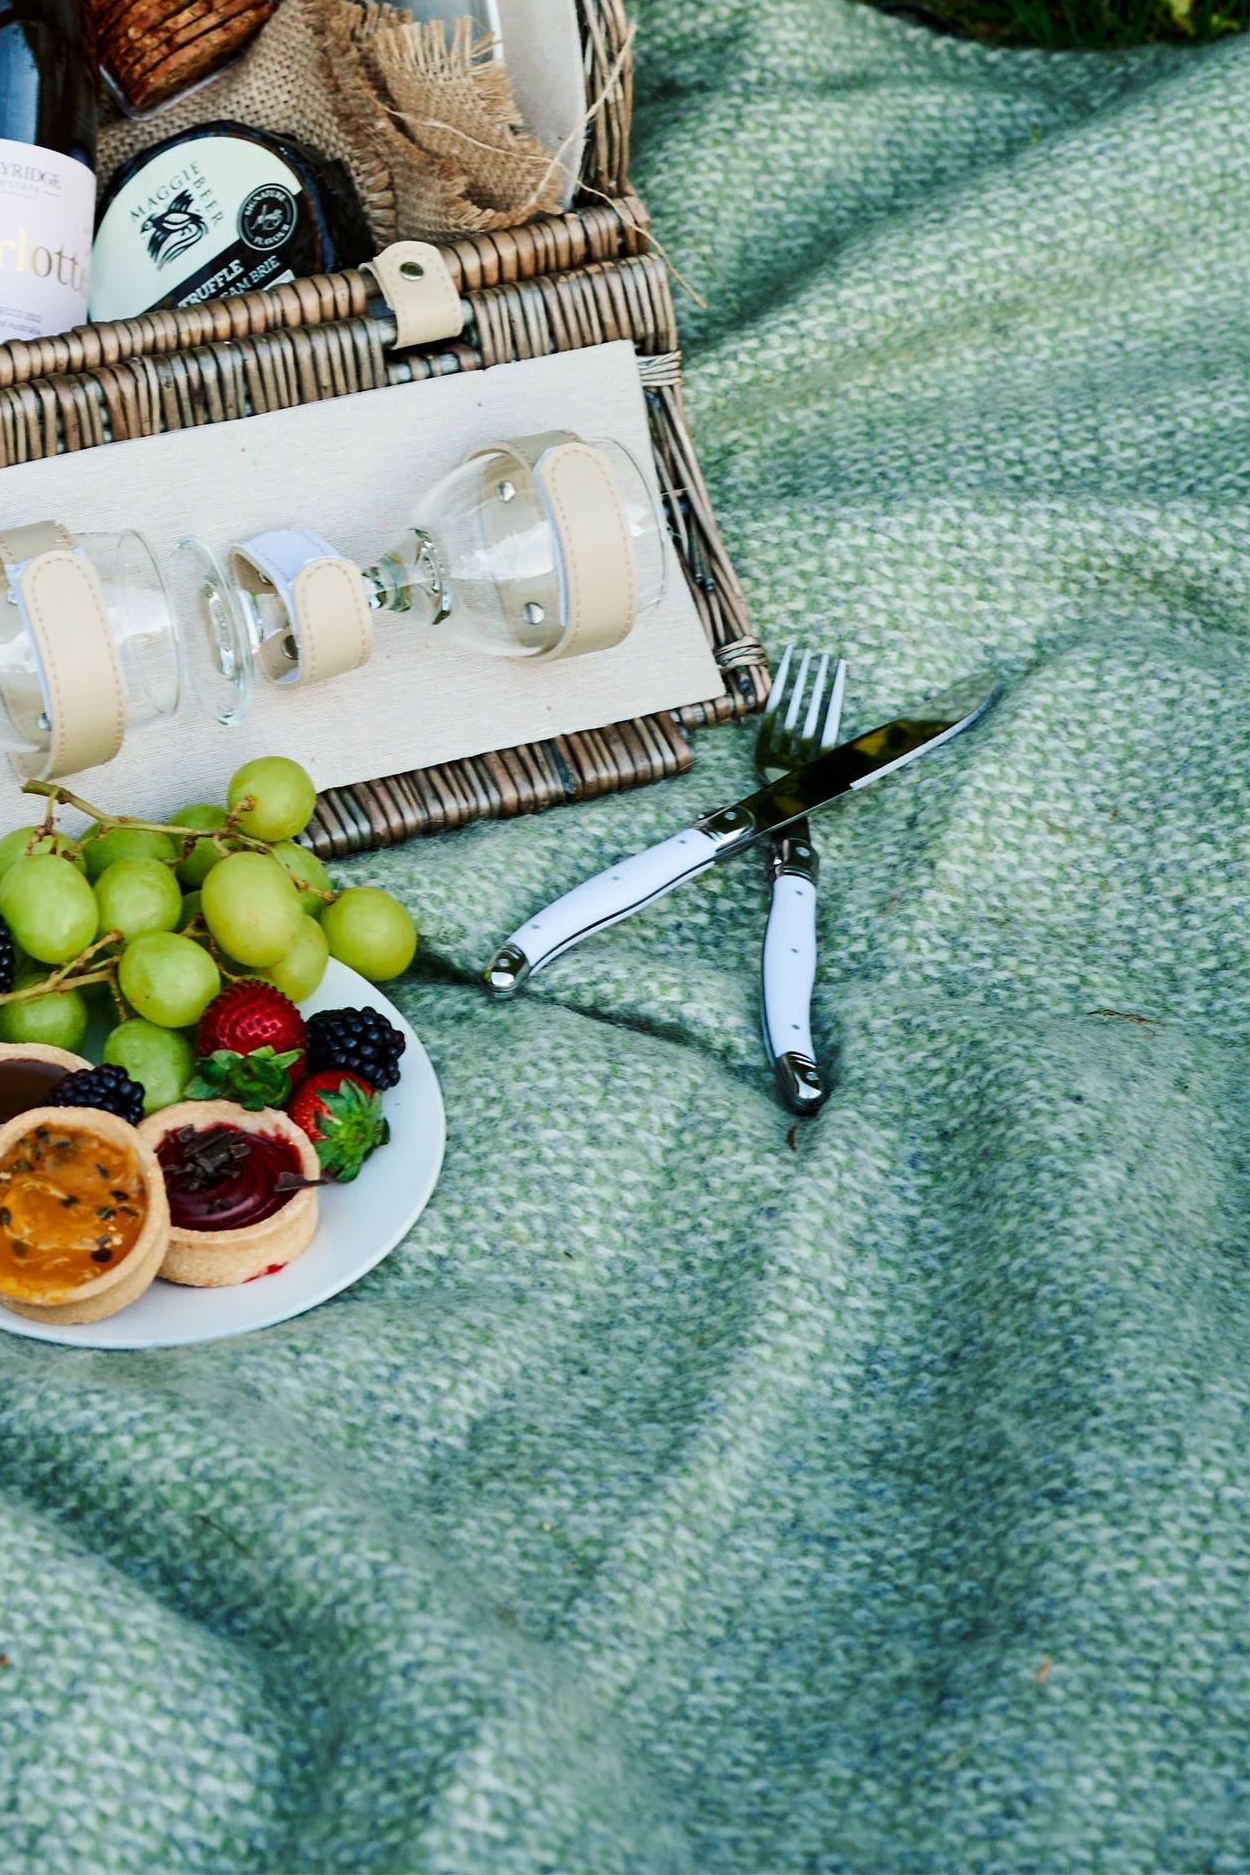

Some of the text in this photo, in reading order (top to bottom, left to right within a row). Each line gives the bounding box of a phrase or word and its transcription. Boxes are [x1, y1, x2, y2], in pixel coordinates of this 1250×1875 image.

[129, 160, 225, 227] MAGGIE BEER
[177, 258, 245, 308] TRUFFLE
[248, 255, 282, 284] BRIE
